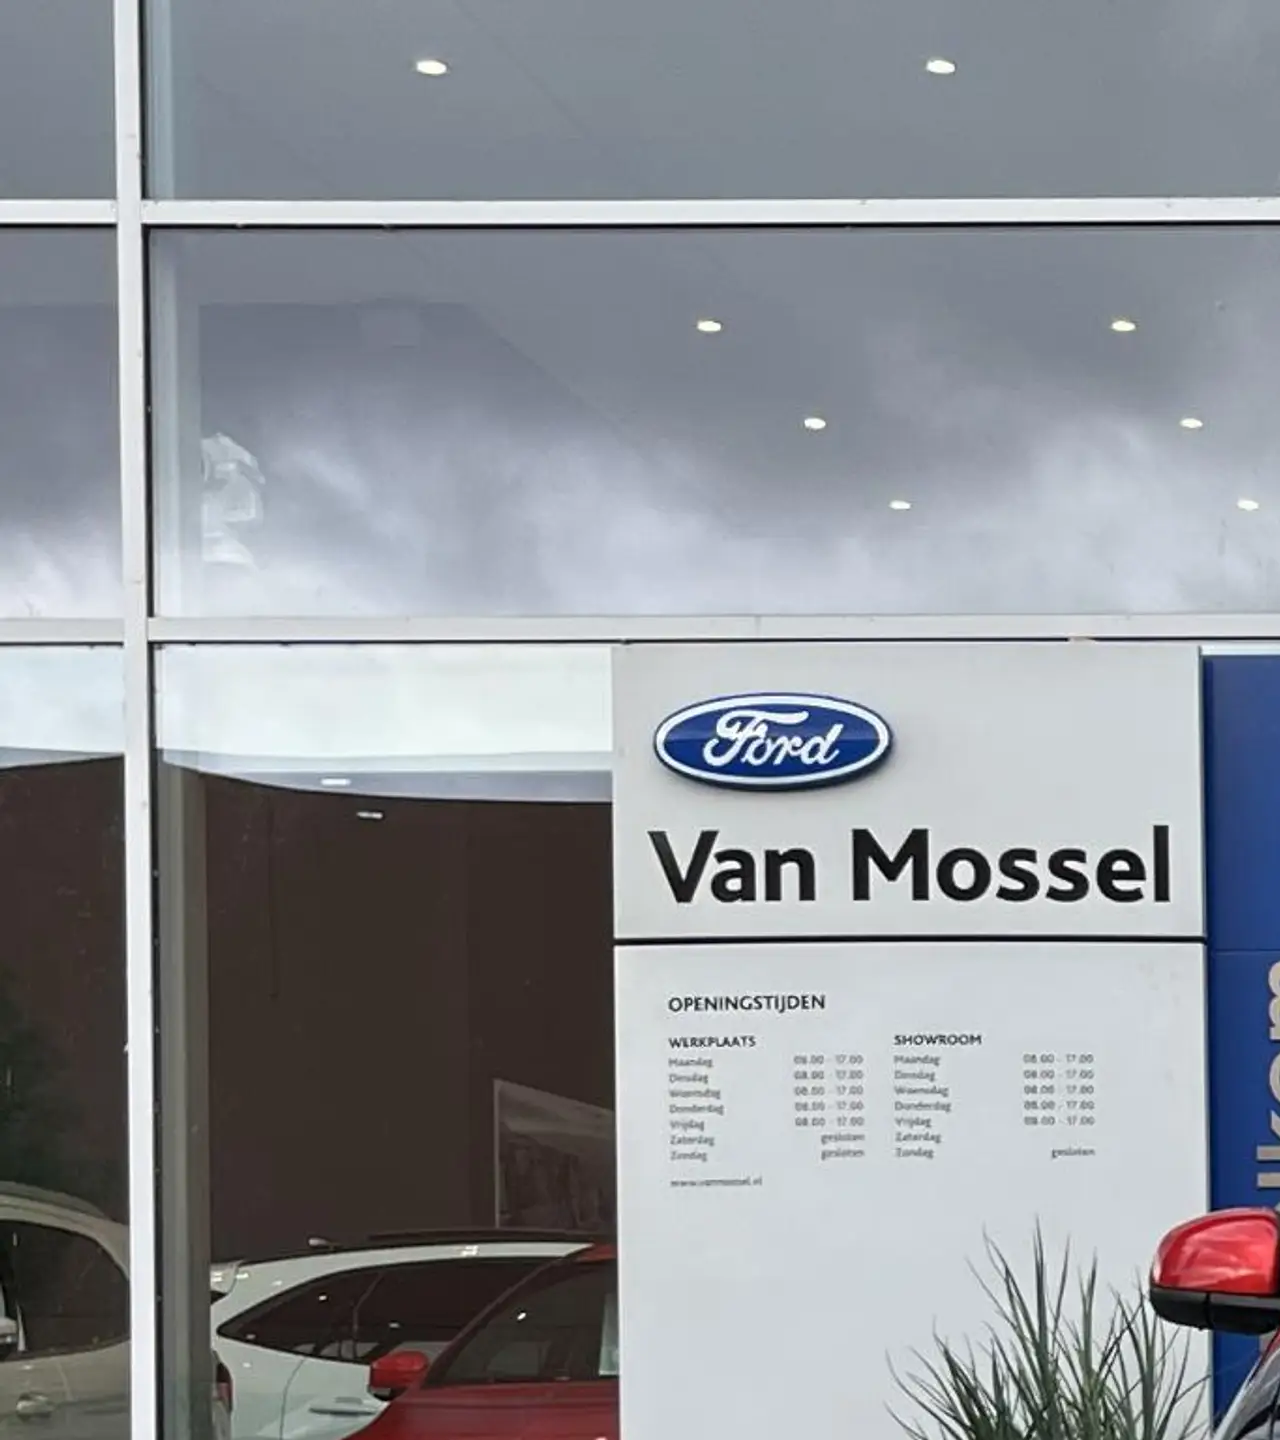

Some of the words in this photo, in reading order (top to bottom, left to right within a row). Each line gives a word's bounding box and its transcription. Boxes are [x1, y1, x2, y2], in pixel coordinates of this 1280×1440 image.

[702, 709, 844, 767] Ford
[647, 830, 816, 903] Van
[852, 825, 1170, 903] Mossel
[667, 994, 826, 1013] OPENINGSTIJDEN
[668, 1035, 756, 1049] WERKPLAATS
[893, 1034, 982, 1047] SHOWROOM
